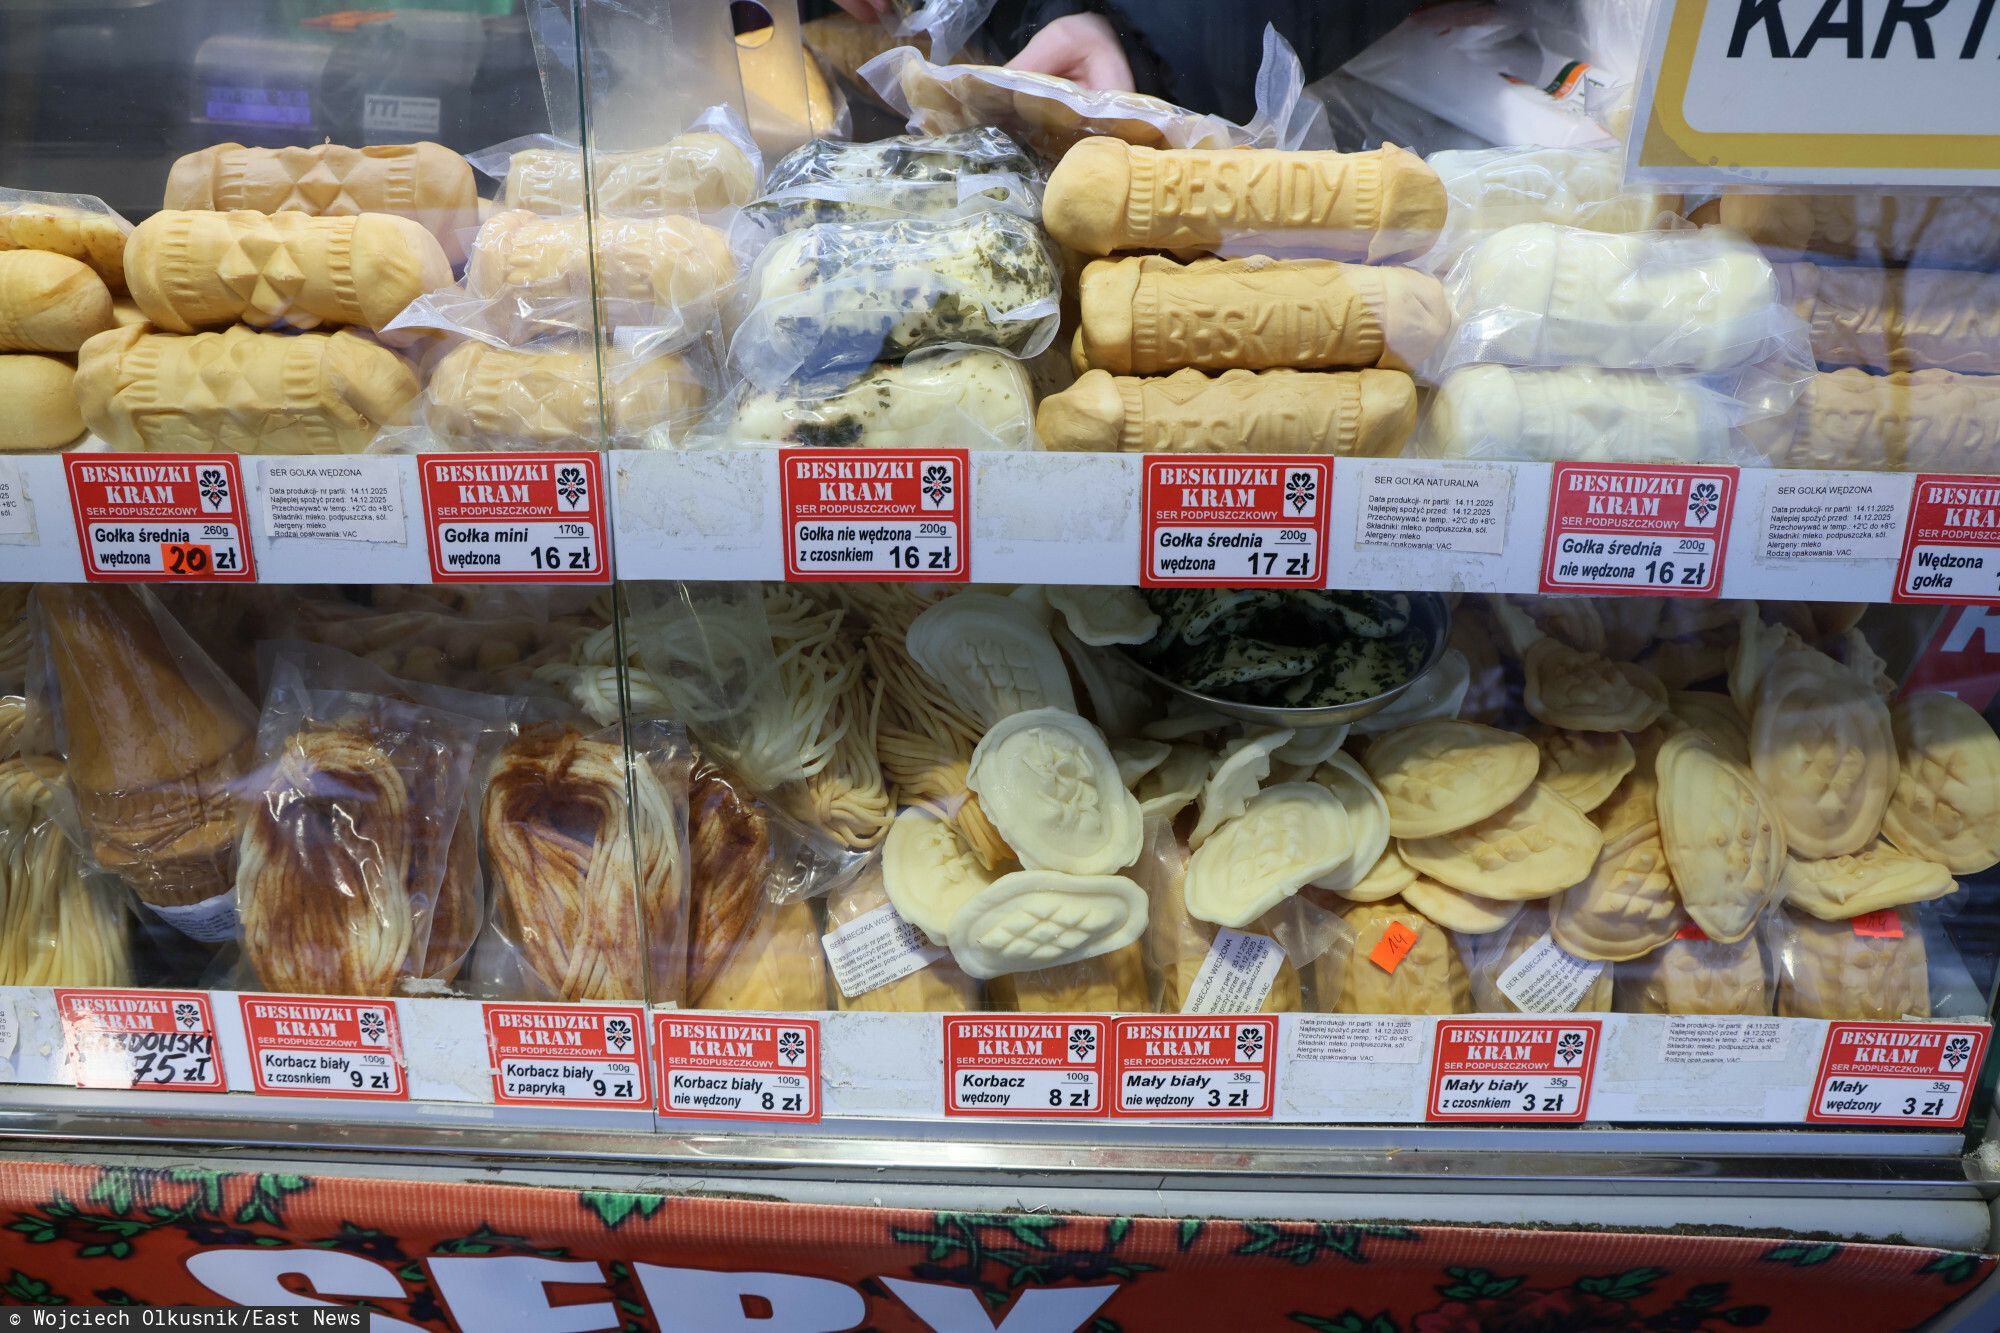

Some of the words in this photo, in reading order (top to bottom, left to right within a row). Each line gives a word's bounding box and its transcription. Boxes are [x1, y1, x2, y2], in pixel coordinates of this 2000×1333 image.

[1727, 0, 2000, 59] KART
[1154, 156, 1349, 224] BESKIDY
[1166, 294, 1357, 361] BESKIDY
[81, 465, 191, 483] BESKIDZKI
[435, 464, 549, 482] BESKIDZKI
[796, 462, 914, 479] BESKIDZKI
[1160, 468, 1278, 485] BESKIDZKI
[1375, 476, 1392, 484] SER
[1427, 478, 1479, 488] NATURALNA
[1568, 475, 1685, 495] BESKIDZKI
[105, 485, 175, 504] KRAM
[459, 485, 530, 503] KRAM
[819, 483, 893, 500] KRAM
[1182, 489, 1255, 507] KRAM
[86, 507, 107, 515] SER
[109, 507, 197, 515] PODPUSZCZKOWY
[462, 507, 553, 515] PODPUSZCZKOWY
[796, 505, 817, 513] SER
[820, 505, 916, 513] PODPUSZCZKOWY
[1587, 496, 1661, 516] KRAM
[1156, 511, 1177, 519] SER
[1181, 512, 1278, 520] PODPUSZCZKOWY
[1562, 517, 1582, 526] SER
[1586, 518, 1679, 529] PODPUSZCZKOWY
[1944, 508, 2000, 527] KRA
[95, 528, 134, 542] Gołka
[139, 528, 189, 543] średnia
[203, 526, 228, 537] 260g
[445, 529, 489, 542] Gołka
[495, 529, 528, 542] mini
[559, 525, 584, 535] 170g
[800, 527, 834, 541] Gołka
[838, 527, 855, 541] nie
[859, 527, 911, 544] wędzona
[920, 524, 946, 535] 200g
[1280, 530, 1306, 541] 200g
[1918, 529, 1939, 538] SER
[1160, 532, 1203, 548] Gołka
[1207, 533, 1263, 548] średnia
[1563, 538, 1604, 554] Gołka
[1608, 540, 1662, 556] średnia
[1679, 540, 1705, 551] 200g
[100, 551, 150, 567] wędzona
[169, 547, 207, 574] 20
[216, 547, 236, 569] zł
[448, 551, 501, 568] wędzona
[531, 547, 561, 569] 16
[569, 547, 590, 569] zł
[801, 550, 807, 561] z
[810, 547, 873, 561] czosnkiem
[890, 546, 919, 568] 16
[929, 546, 951, 568] zł
[1918, 552, 1983, 570] Wędzona
[1161, 556, 1216, 573] wędzona
[1248, 553, 1278, 575] 17
[1286, 553, 1309, 575] zł
[1559, 563, 1579, 576] nie
[1582, 563, 1635, 580] wędzona
[1646, 561, 1675, 584] 16
[1681, 563, 1705, 584] zł
[1912, 574, 1952, 590] gołka
[255, 1005, 352, 1021] BESKIDZKI
[275, 1021, 338, 1037] KRAM
[499, 1014, 599, 1030] BESKIDZKI
[519, 1030, 582, 1046] KRAM
[670, 1024, 771, 1041] BESKIDZKI
[958, 1025, 1062, 1038] BESKIDZKI
[1126, 1025, 1230, 1039] BESKIDZKI
[1450, 1030, 1553, 1043] BESKIDZKI
[1840, 1032, 1942, 1047] BESKIDZKI
[279, 1038, 358, 1047] PODPUSZCZKOWY
[690, 1041, 753, 1057] KRAM
[978, 1041, 1042, 1055] KRAM
[1146, 1041, 1210, 1056] KRAM
[521, 1047, 602, 1056] PODPUSZCZKOWY
[1467, 1046, 1532, 1060] KRAM
[1855, 1048, 1919, 1063] KRAM
[265, 1055, 316, 1068] Korbacz
[320, 1058, 349, 1072] biały
[363, 1056, 385, 1064] 100g
[607, 1064, 630, 1072] 100g
[690, 1058, 773, 1068] PODPUSZCZKOWY
[132, 1053, 186, 1085] 75
[507, 1064, 559, 1077] Korbacz
[563, 1066, 593, 1081] biały
[1066, 1073, 1088, 1081] 100g
[1851, 1065, 1934, 1074] PODPUSZCZKOWY
[268, 1074, 273, 1082] z
[276, 1072, 330, 1085] czosnkiem
[351, 1071, 363, 1087] 9
[371, 1072, 389, 1089] zł
[674, 1076, 727, 1089] Korbacz
[731, 1078, 763, 1093] biały
[778, 1076, 800, 1086] 100g
[963, 1074, 1025, 1087] Korbacz
[1126, 1076, 1166, 1089] Mały
[1170, 1076, 1210, 1088] biały
[1234, 1073, 1251, 1082] 35g
[1551, 1078, 1567, 1087] 35g
[509, 1083, 514, 1091] z
[518, 1083, 565, 1096] papryką
[593, 1080, 606, 1097] 9
[614, 1081, 633, 1097] zł
[1444, 1079, 1484, 1093] Mały
[1488, 1079, 1529, 1093] biały
[1829, 1080, 1868, 1095] Mały
[1933, 1082, 1950, 1091] 35g
[674, 1093, 690, 1104] nie
[693, 1095, 741, 1109] wędzony
[761, 1093, 774, 1110] 8
[783, 1094, 802, 1111] zł
[962, 1092, 1010, 1105] wędzony
[1050, 1089, 1062, 1106] 8
[1070, 1089, 1090, 1106] zł
[1126, 1095, 1143, 1105] nie
[1146, 1094, 1194, 1108] wędzony
[1208, 1090, 1220, 1107] 3
[1229, 1090, 1249, 1107] zł
[1443, 1100, 1448, 1108] z
[1452, 1098, 1510, 1109] czosnkiem
[1523, 1094, 1535, 1111] 3
[1543, 1094, 1563, 1111] zł
[1826, 1099, 1881, 1113] wędzony
[1902, 1098, 1916, 1115] 3
[1922, 1098, 1943, 1116] zł
